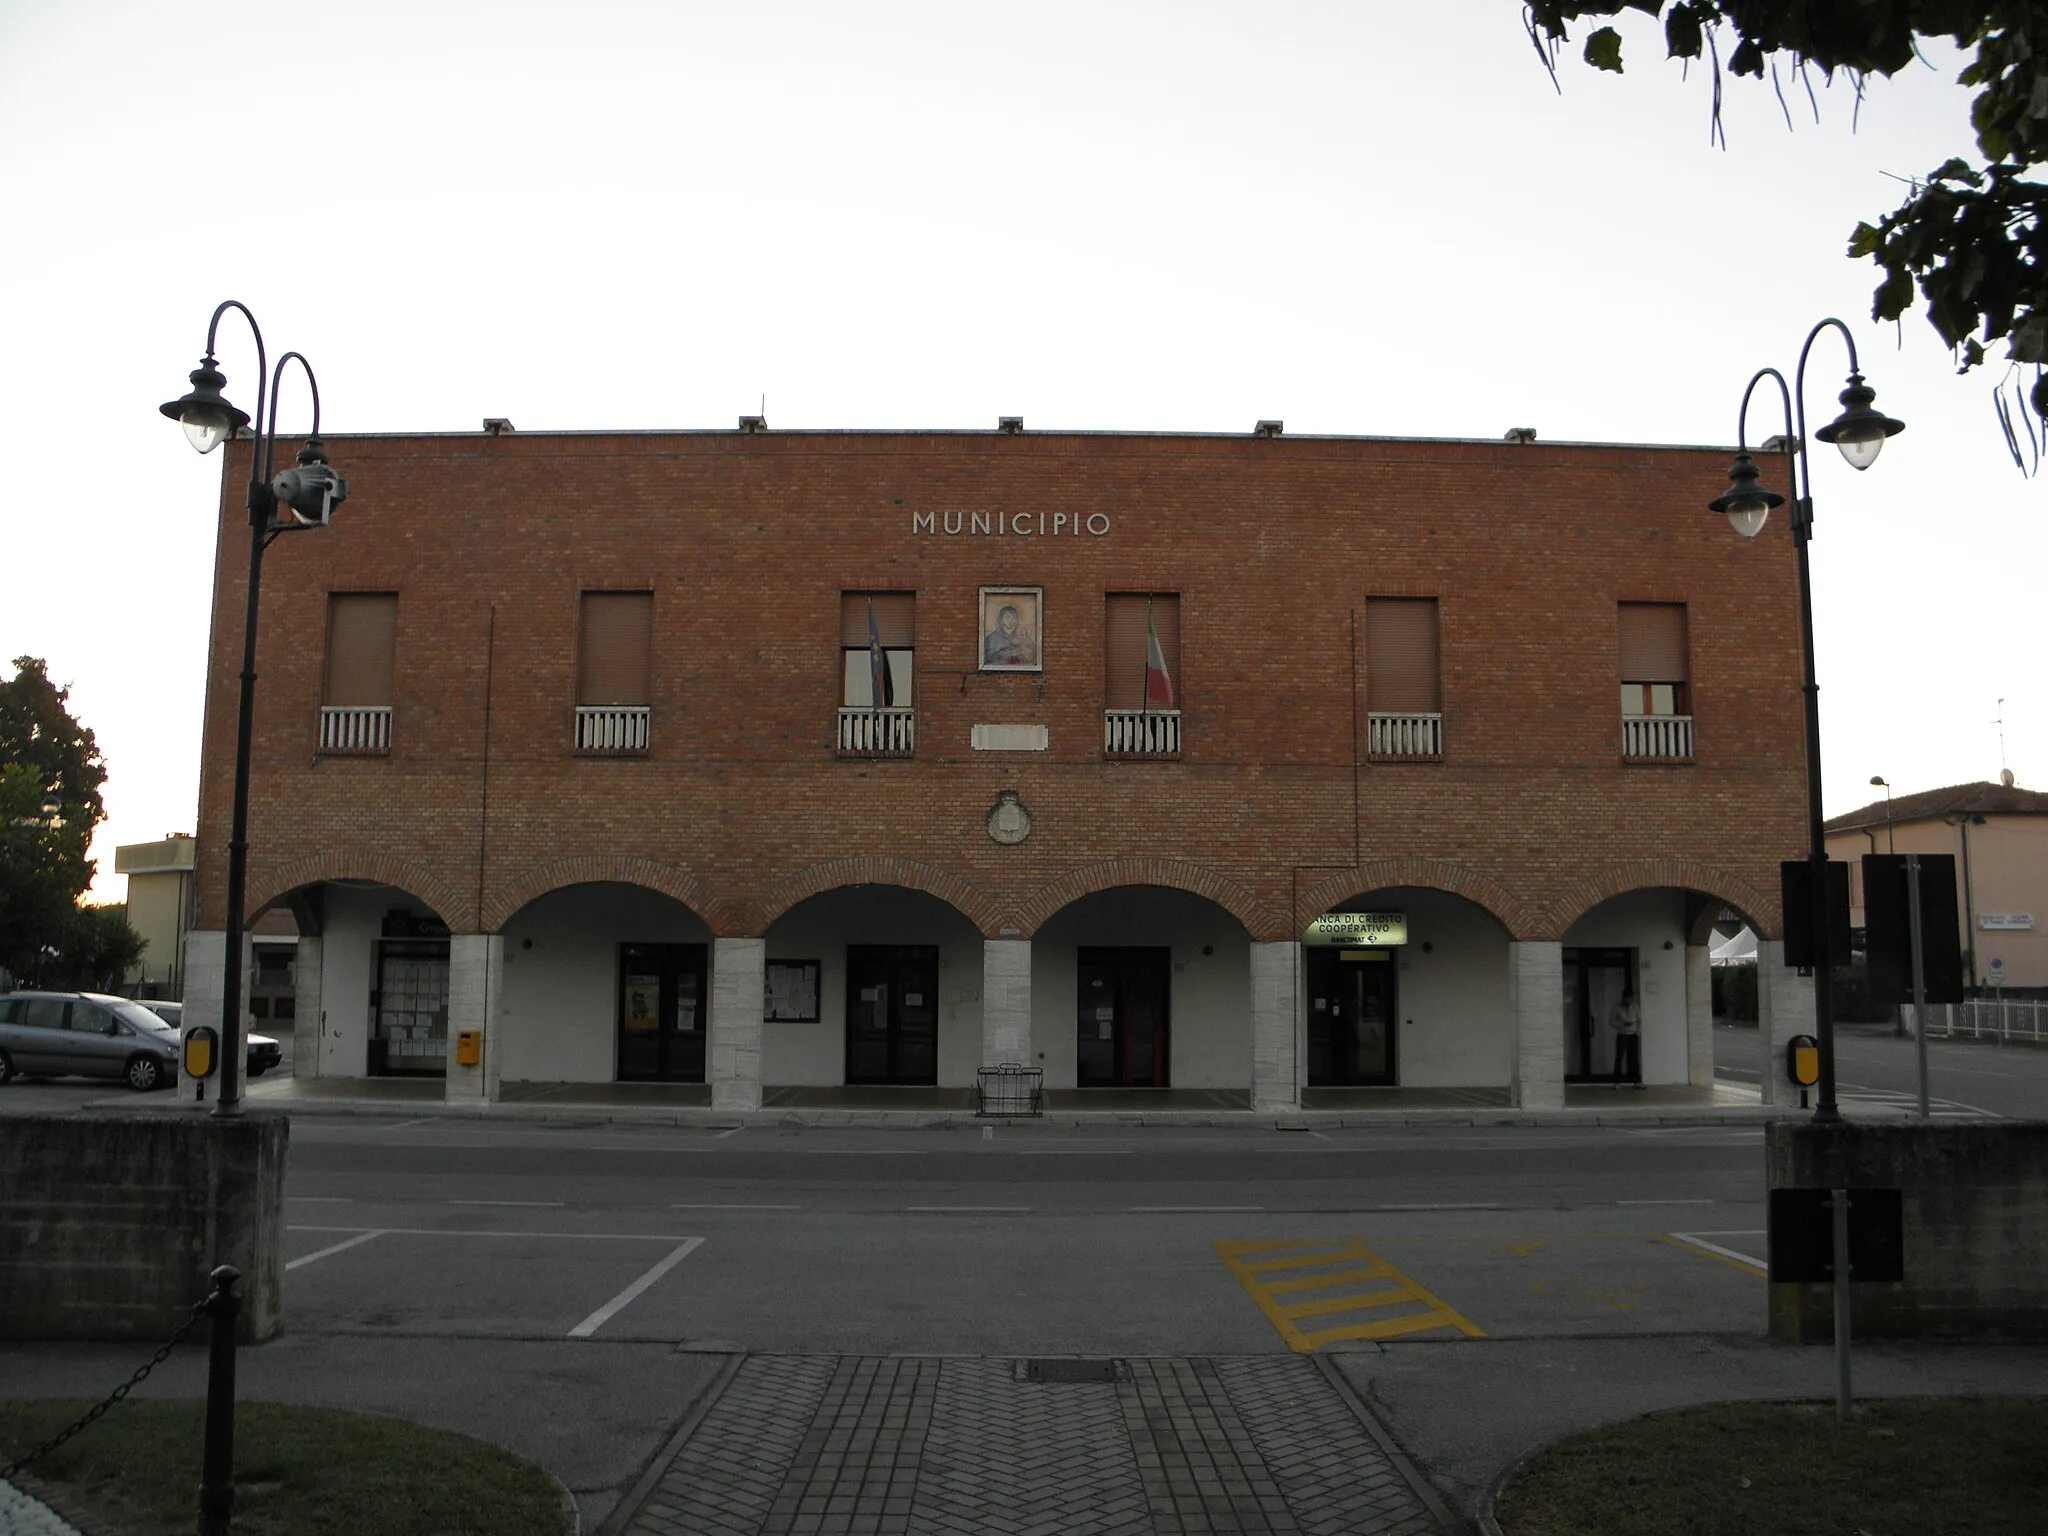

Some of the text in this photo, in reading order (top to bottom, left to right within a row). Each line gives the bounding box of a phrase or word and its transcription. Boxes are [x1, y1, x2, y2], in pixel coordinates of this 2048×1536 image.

[912, 511, 1111, 536] MUNICIPIO
[1345, 915, 1355, 923] DI
[1359, 915, 1402, 923] CREDITO
[1319, 924, 1389, 932] COOPERATIVO
